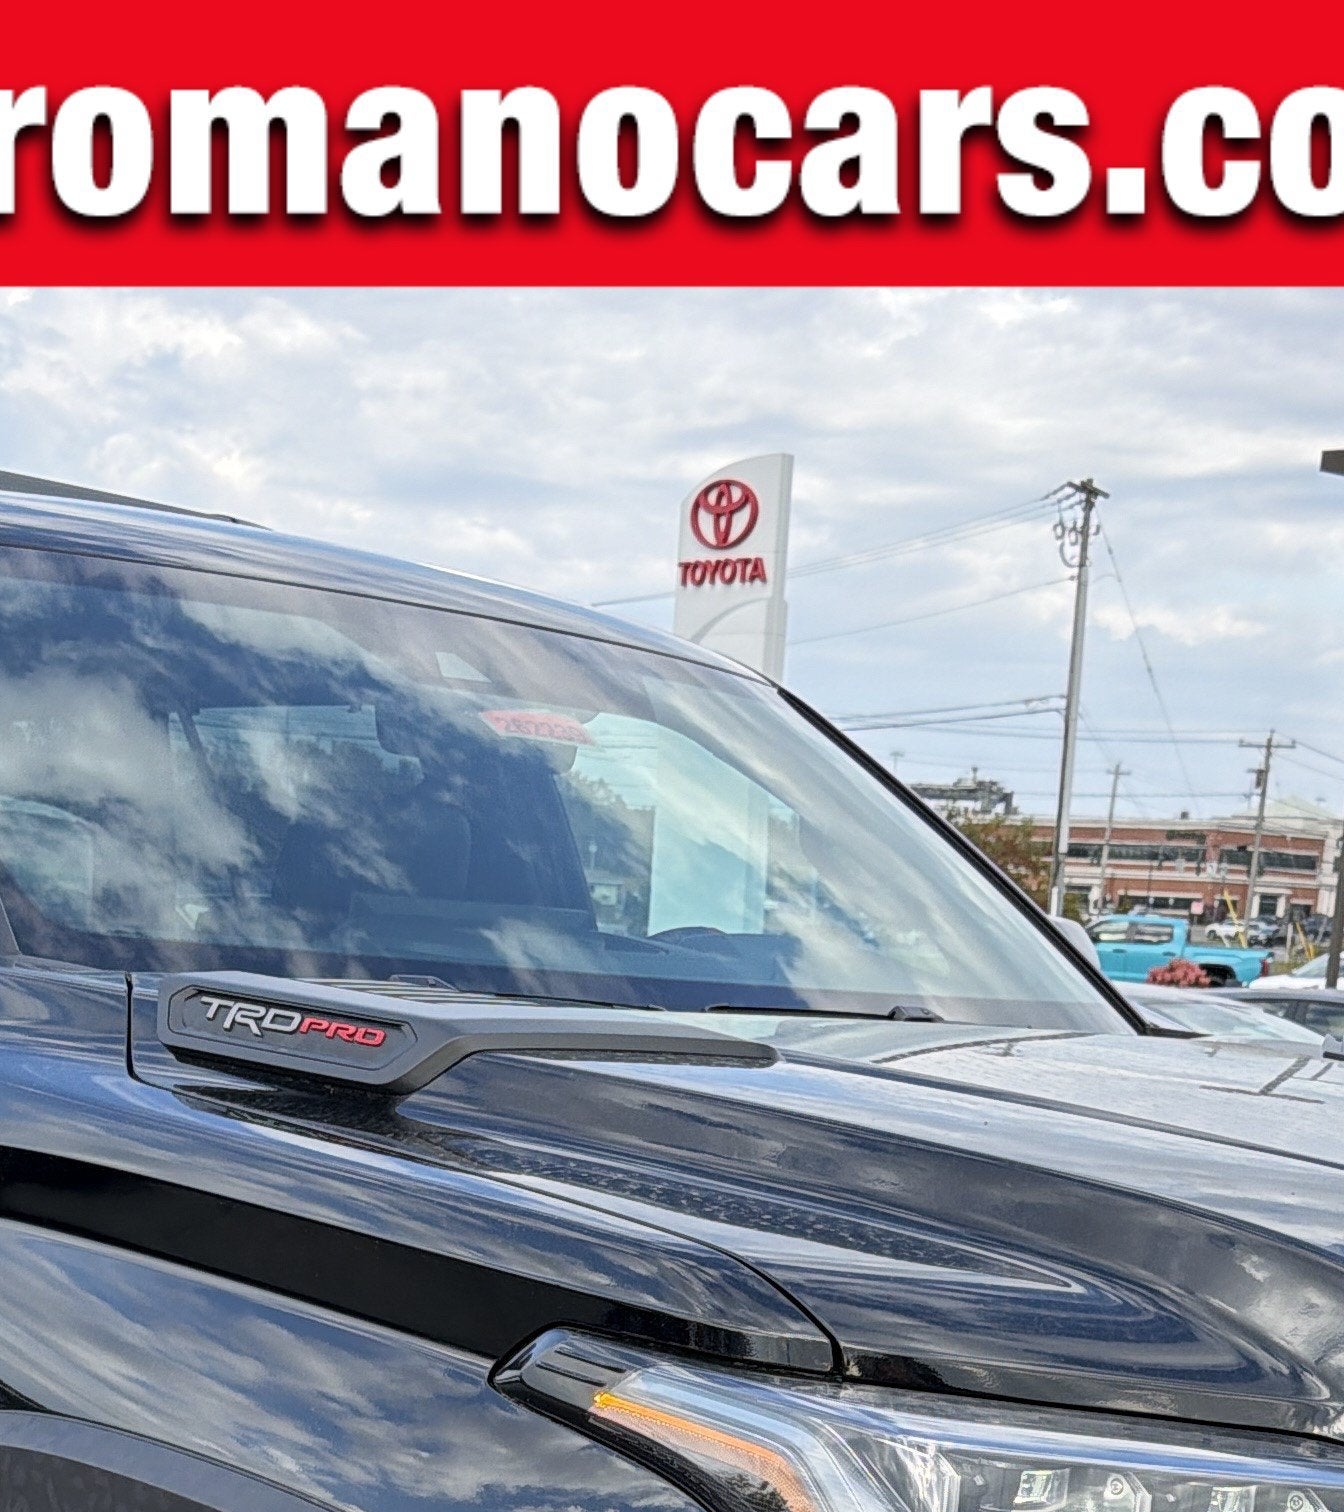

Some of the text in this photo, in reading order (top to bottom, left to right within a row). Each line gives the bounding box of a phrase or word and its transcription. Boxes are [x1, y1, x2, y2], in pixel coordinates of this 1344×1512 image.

[678, 557, 767, 587] TOYOTA
[201, 995, 387, 1047] TRD PRO
